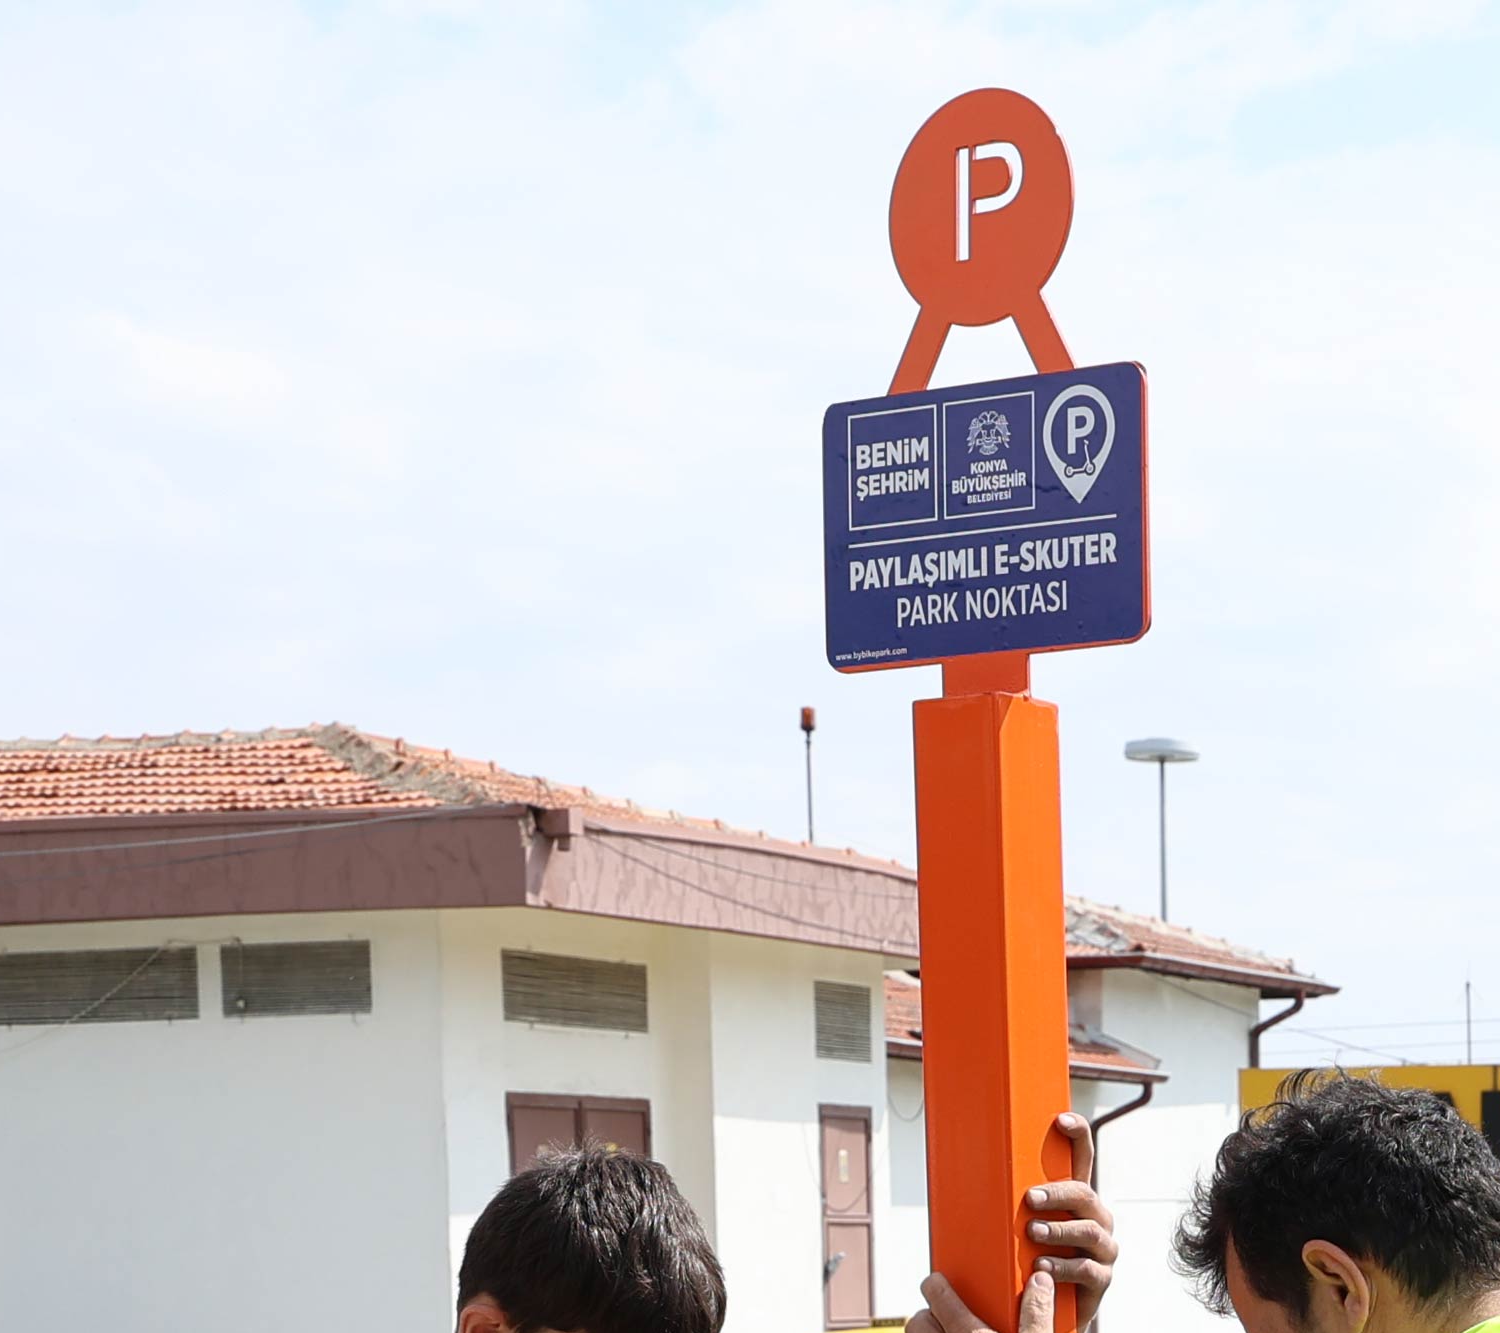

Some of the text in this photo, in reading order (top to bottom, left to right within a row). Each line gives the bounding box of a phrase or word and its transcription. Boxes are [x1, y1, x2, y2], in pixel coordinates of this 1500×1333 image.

[956, 140, 1024, 262] P
[1066, 406, 1096, 455] P
[952, 469, 1027, 495] BÜYÜKŞEHİR
[970, 459, 1008, 474] KONYA
[967, 489, 1012, 504] BELEDİYESİ
[849, 532, 1117, 591] PAYLAŞIMLI E-SKUTER
[896, 580, 1068, 628] PARK NOKTASI
[835, 646, 908, 661] www.bybikepark.com
